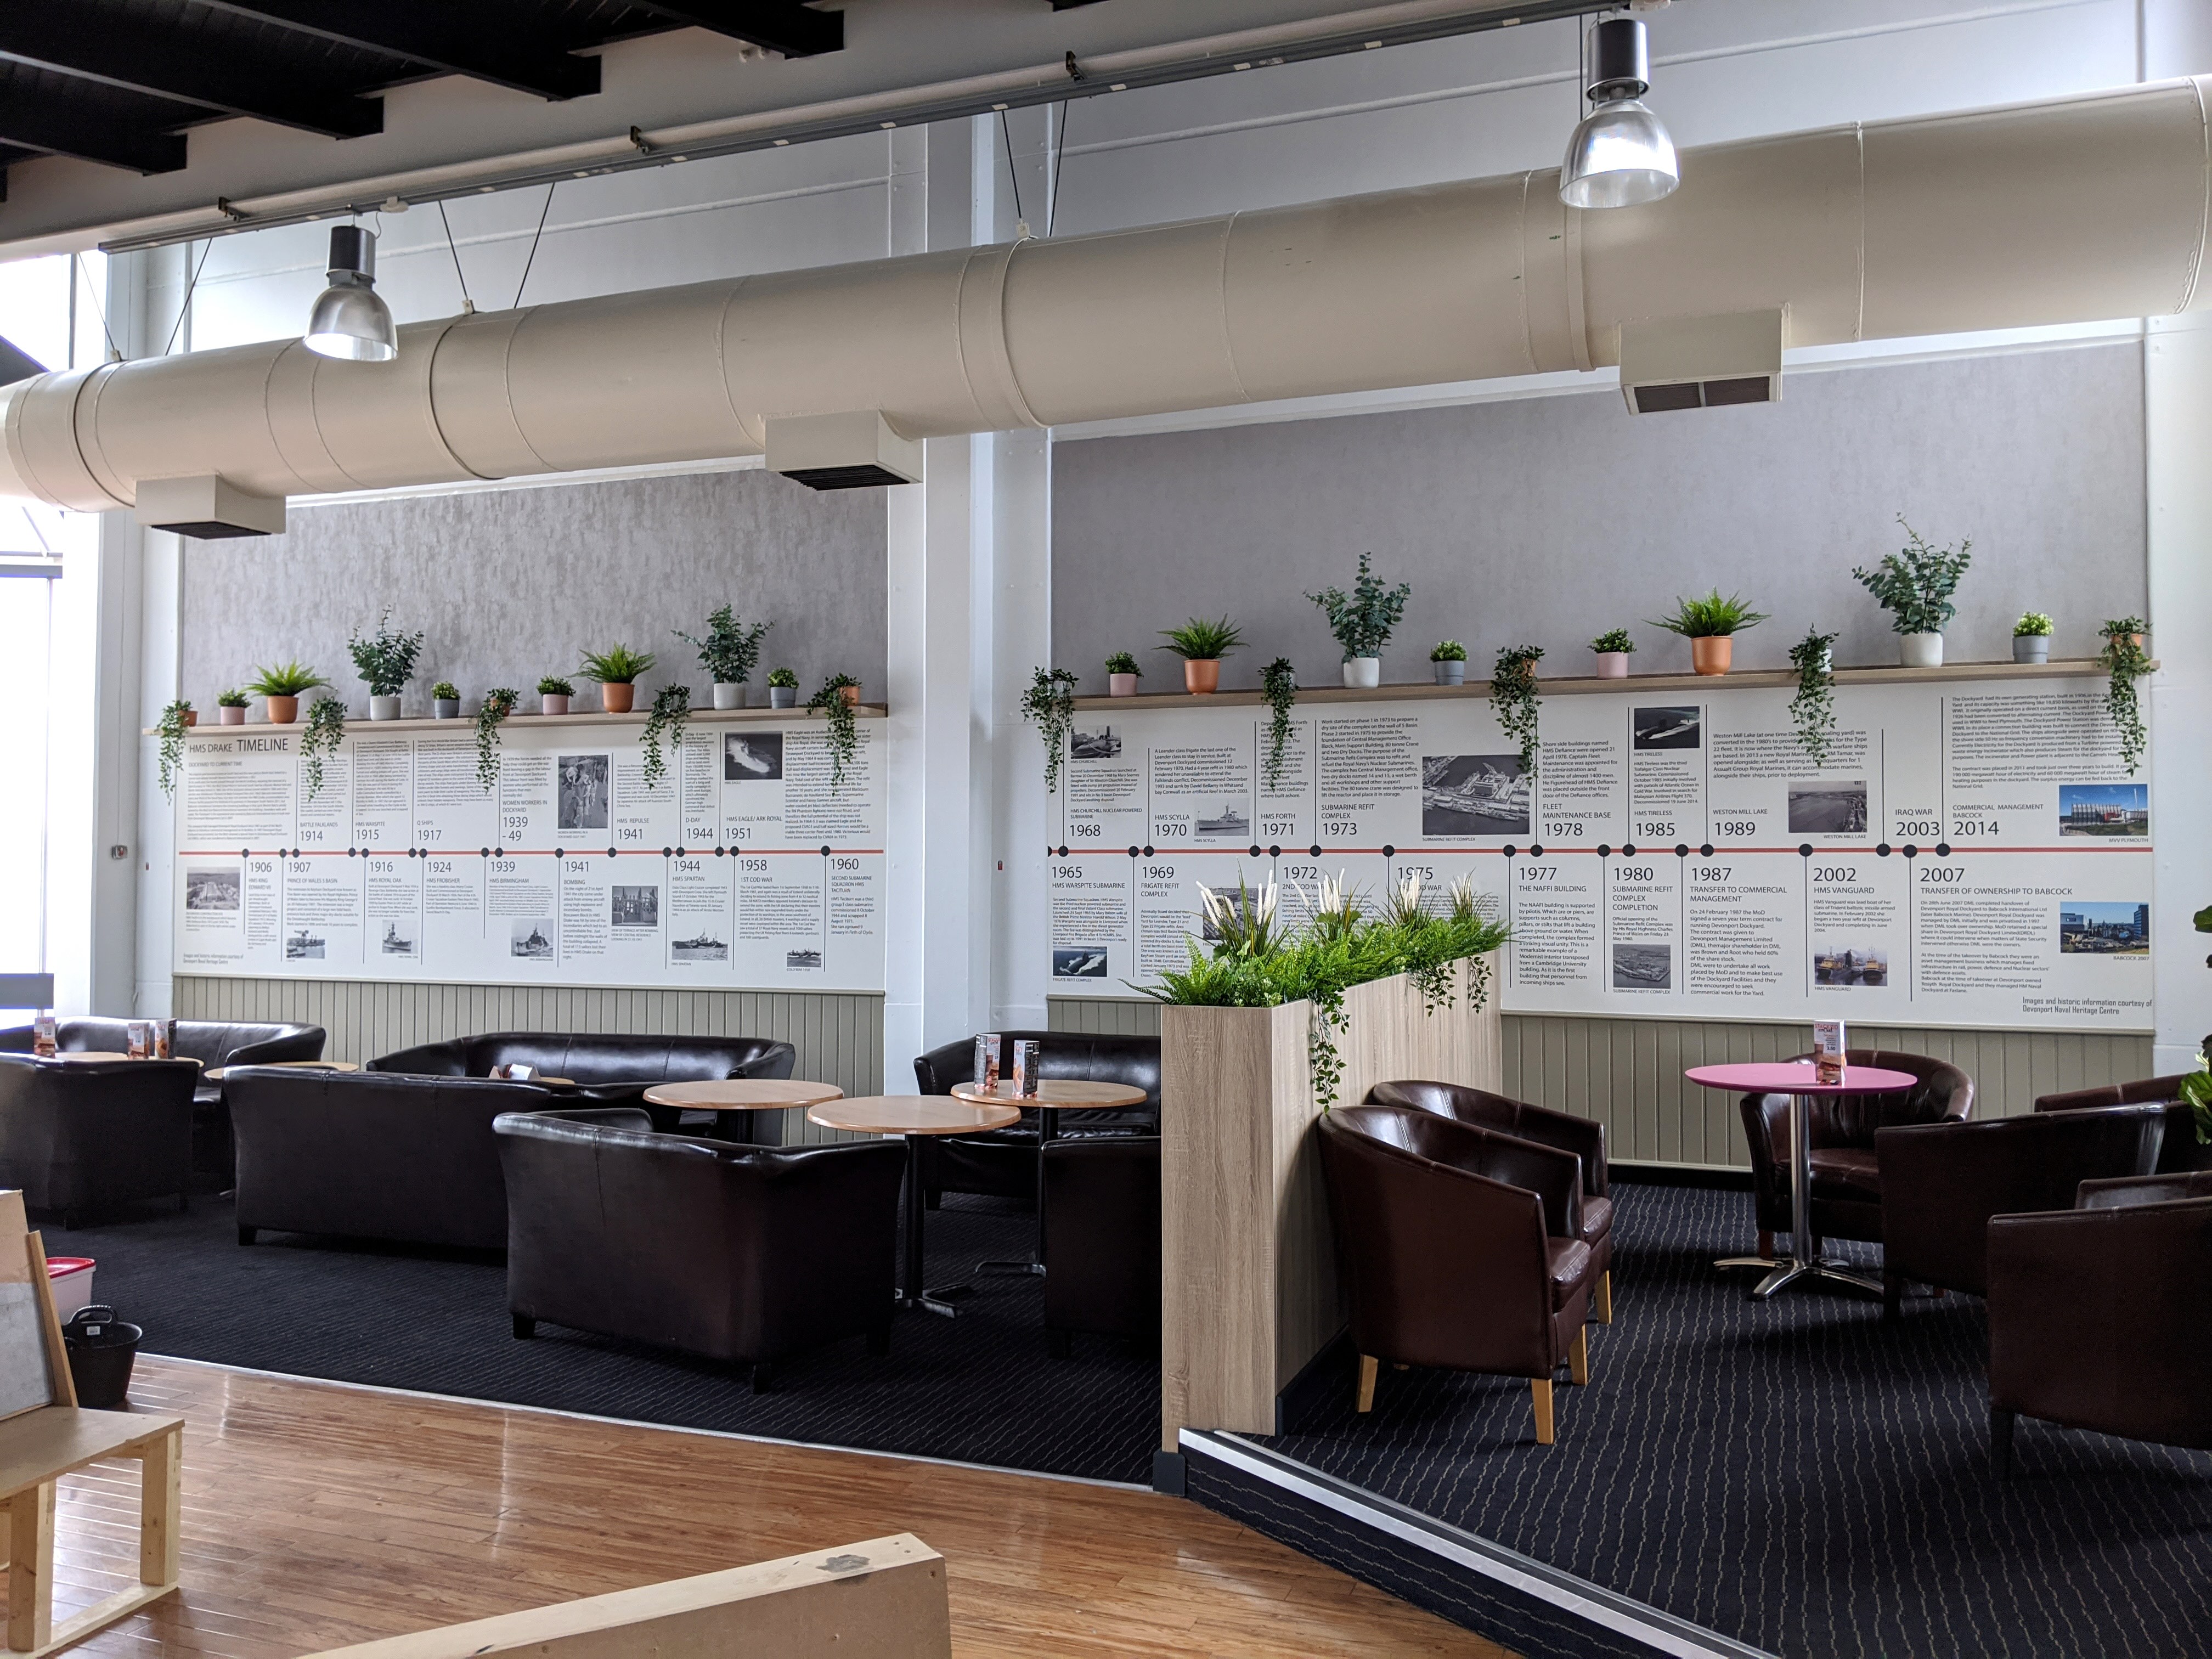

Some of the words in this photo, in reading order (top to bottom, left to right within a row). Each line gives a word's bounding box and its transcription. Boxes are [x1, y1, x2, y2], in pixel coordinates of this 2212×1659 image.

[189, 744, 206, 753] HMS
[208, 743, 233, 752] DRAKE
[236, 738, 288, 752] TIMELINE
[503, 816, 528, 827] 1939
[356, 829, 379, 839] 1915
[618, 828, 642, 839] 1941
[686, 828, 713, 839] 1944
[725, 827, 750, 839] 1951
[1070, 824, 1101, 836] 1968
[1155, 824, 1187, 836] 1970
[1262, 823, 1293, 836] 1971
[1323, 822, 1357, 835] 1973
[1544, 822, 1583, 836] 1978
[1636, 822, 1675, 836] 1985
[1715, 822, 1755, 836] 1989
[1896, 821, 1939, 836] 2003
[1954, 821, 1999, 835] 2014
[300, 830, 323, 841] 1914
[417, 830, 442, 840] 1917
[508, 830, 521, 841] 49
[250, 861, 272, 872] 1906
[289, 861, 311, 872] 1907
[370, 861, 393, 872] 1916
[427, 861, 452, 872] 1924
[490, 861, 515, 872] 1939
[565, 861, 588, 872] 1941
[674, 860, 700, 871] 1944
[740, 859, 767, 871] 1958
[831, 858, 859, 870] 1960
[1052, 866, 1082, 878] 1965
[1142, 866, 1174, 878] 1969
[1284, 866, 1317, 879] 1972
[1398, 867, 1433, 879] 1975
[1519, 867, 1556, 880] 1977
[1614, 867, 1653, 881] 1980
[1691, 867, 1731, 881] 1987
[1813, 867, 1856, 882] 2002
[1920, 867, 1965, 882] 2007
[2023, 997, 2044, 1005] Images
[2082, 998, 2117, 1006] information
[2023, 1005, 2052, 1013] Devonport
[2072, 1006, 2097, 1015] Heritage
